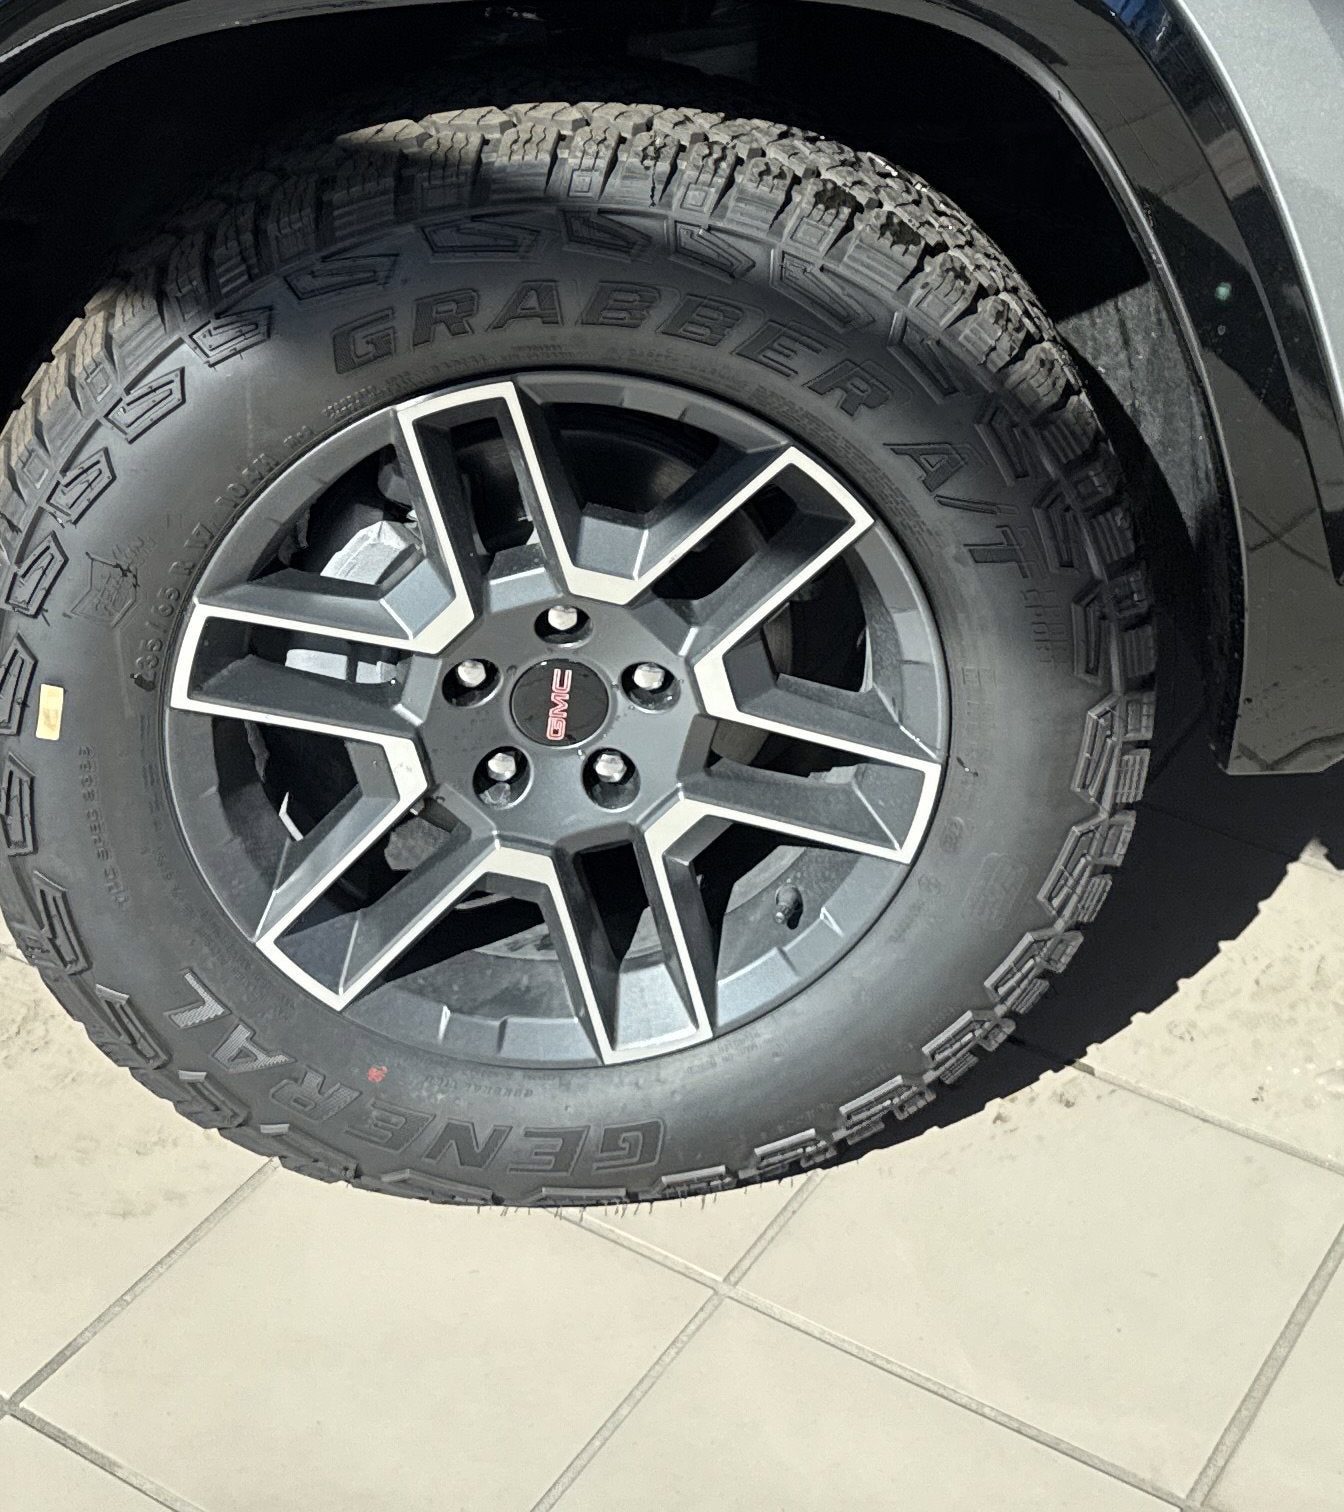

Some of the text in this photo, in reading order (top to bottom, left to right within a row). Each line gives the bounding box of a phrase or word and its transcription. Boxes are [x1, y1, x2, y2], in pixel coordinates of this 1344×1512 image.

[331, 279, 896, 417] GRABBER
[883, 441, 1040, 579] A/T
[546, 668, 573, 741] GMC
[163, 968, 667, 1176] GENERAL
